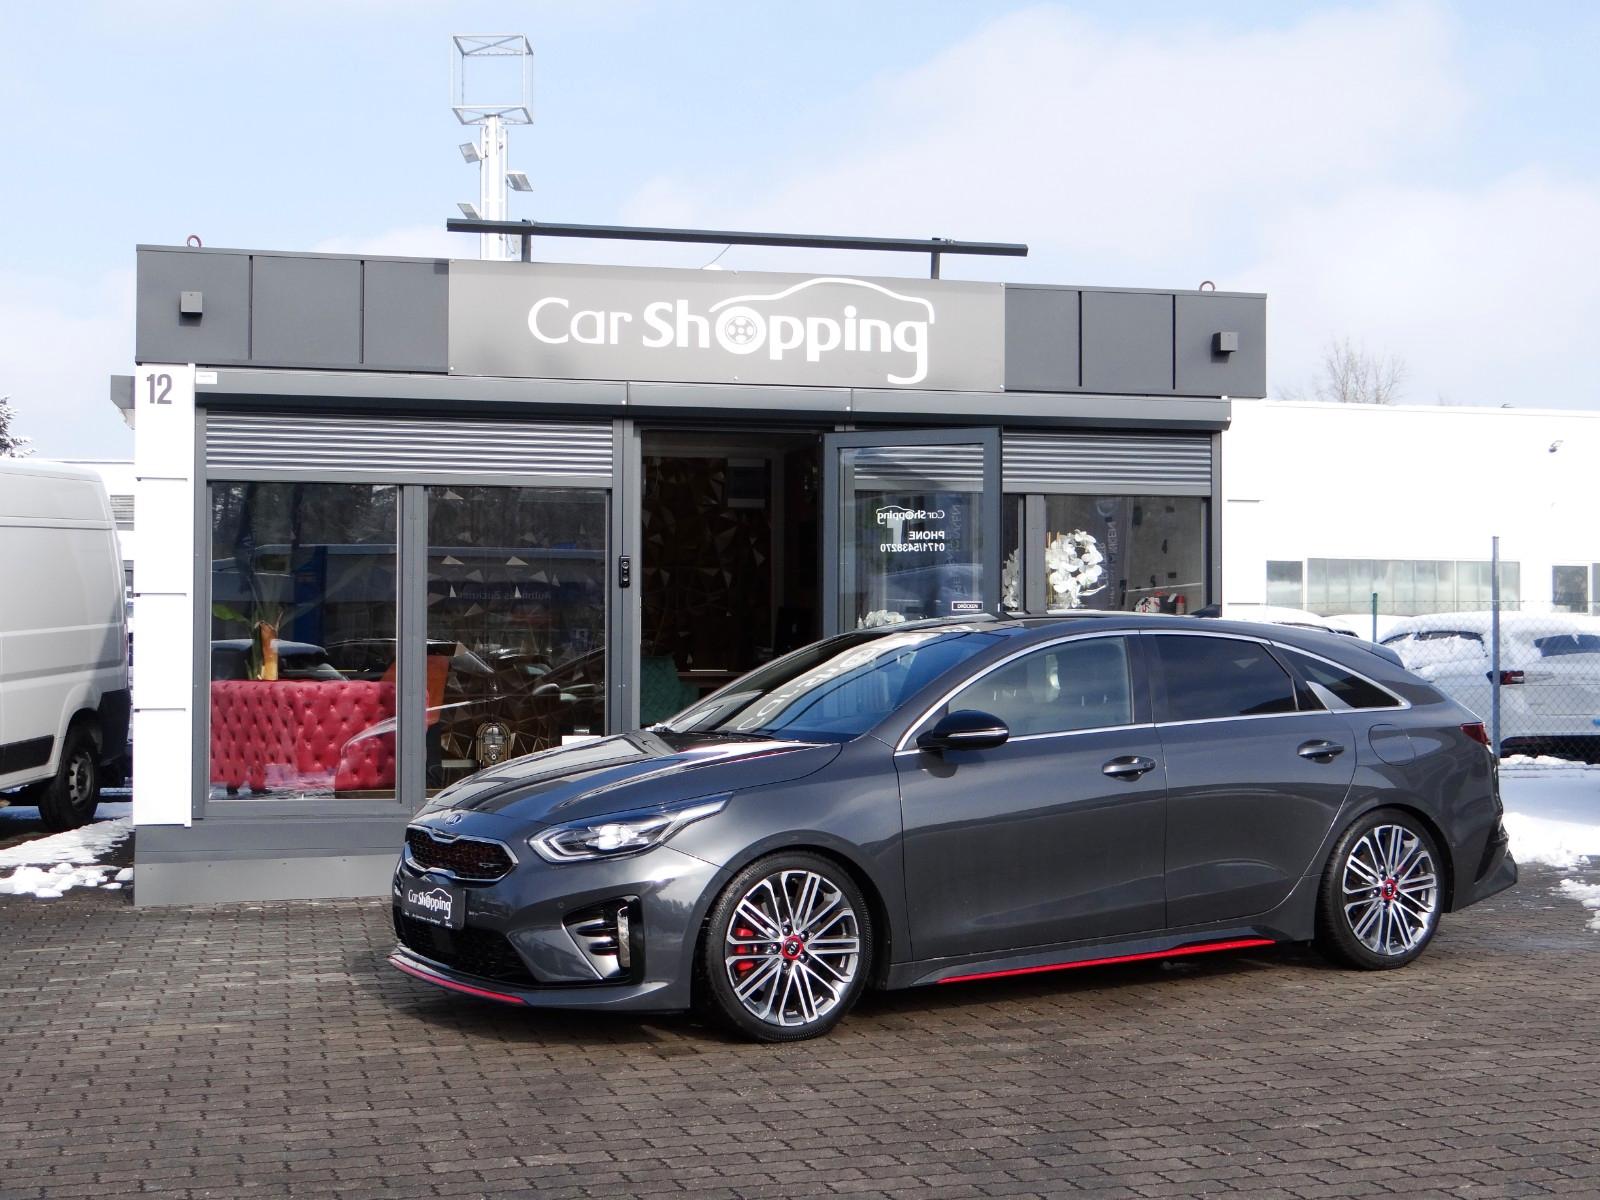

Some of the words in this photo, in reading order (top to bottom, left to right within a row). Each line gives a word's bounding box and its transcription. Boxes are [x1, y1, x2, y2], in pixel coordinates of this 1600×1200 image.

[527, 297, 632, 345] Car
[642, 298, 928, 385] Shopping
[147, 374, 172, 404] 12
[408, 889, 418, 904] Car
[418, 891, 452, 920] Shopping
